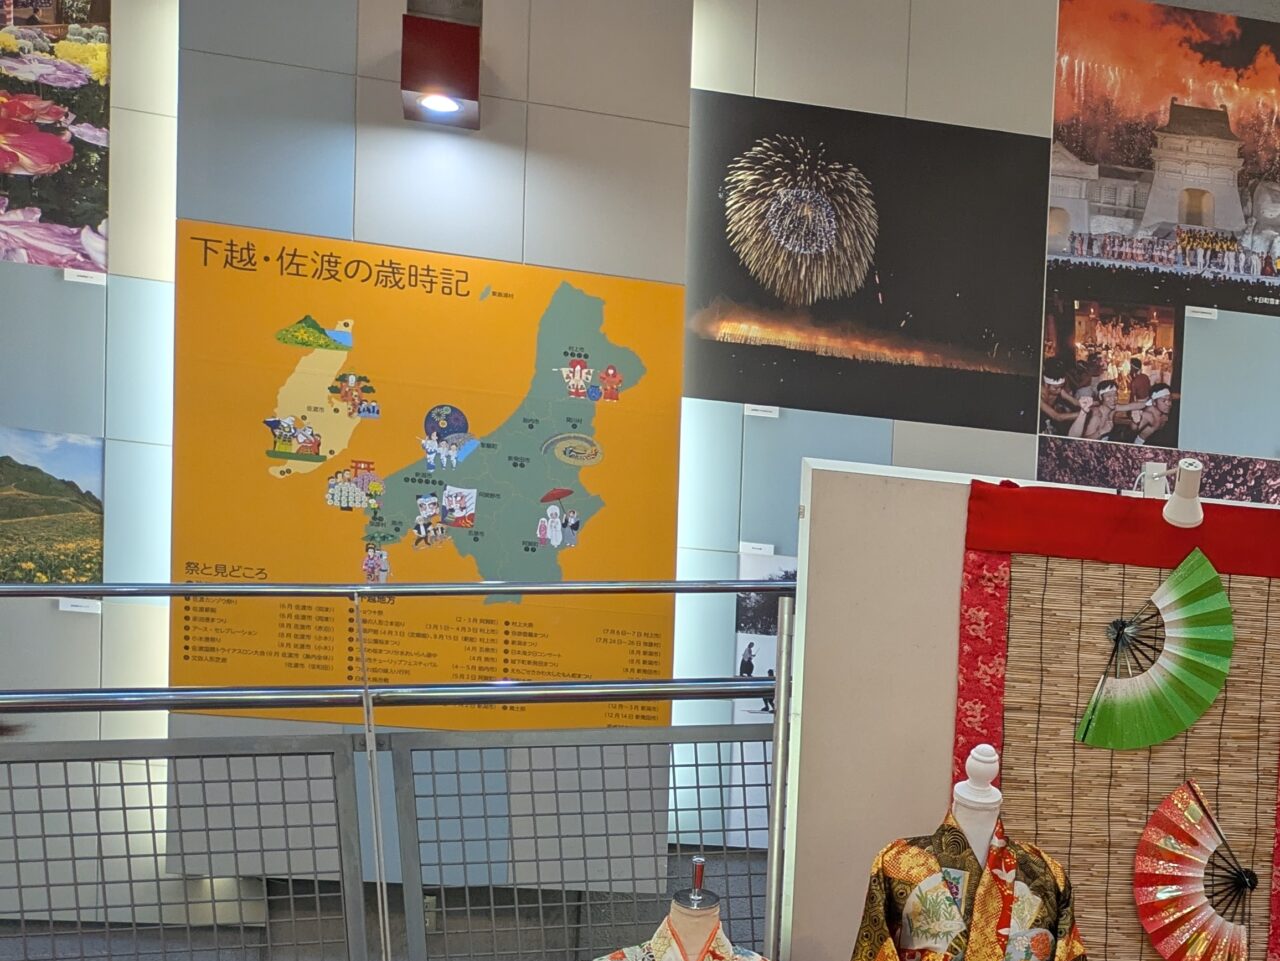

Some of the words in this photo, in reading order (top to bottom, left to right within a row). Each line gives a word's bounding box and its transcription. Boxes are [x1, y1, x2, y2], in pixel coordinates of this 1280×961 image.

[190, 236, 471, 298] 下越・佐渡の歳時記
[185, 561, 268, 580] 祭と見どころ
